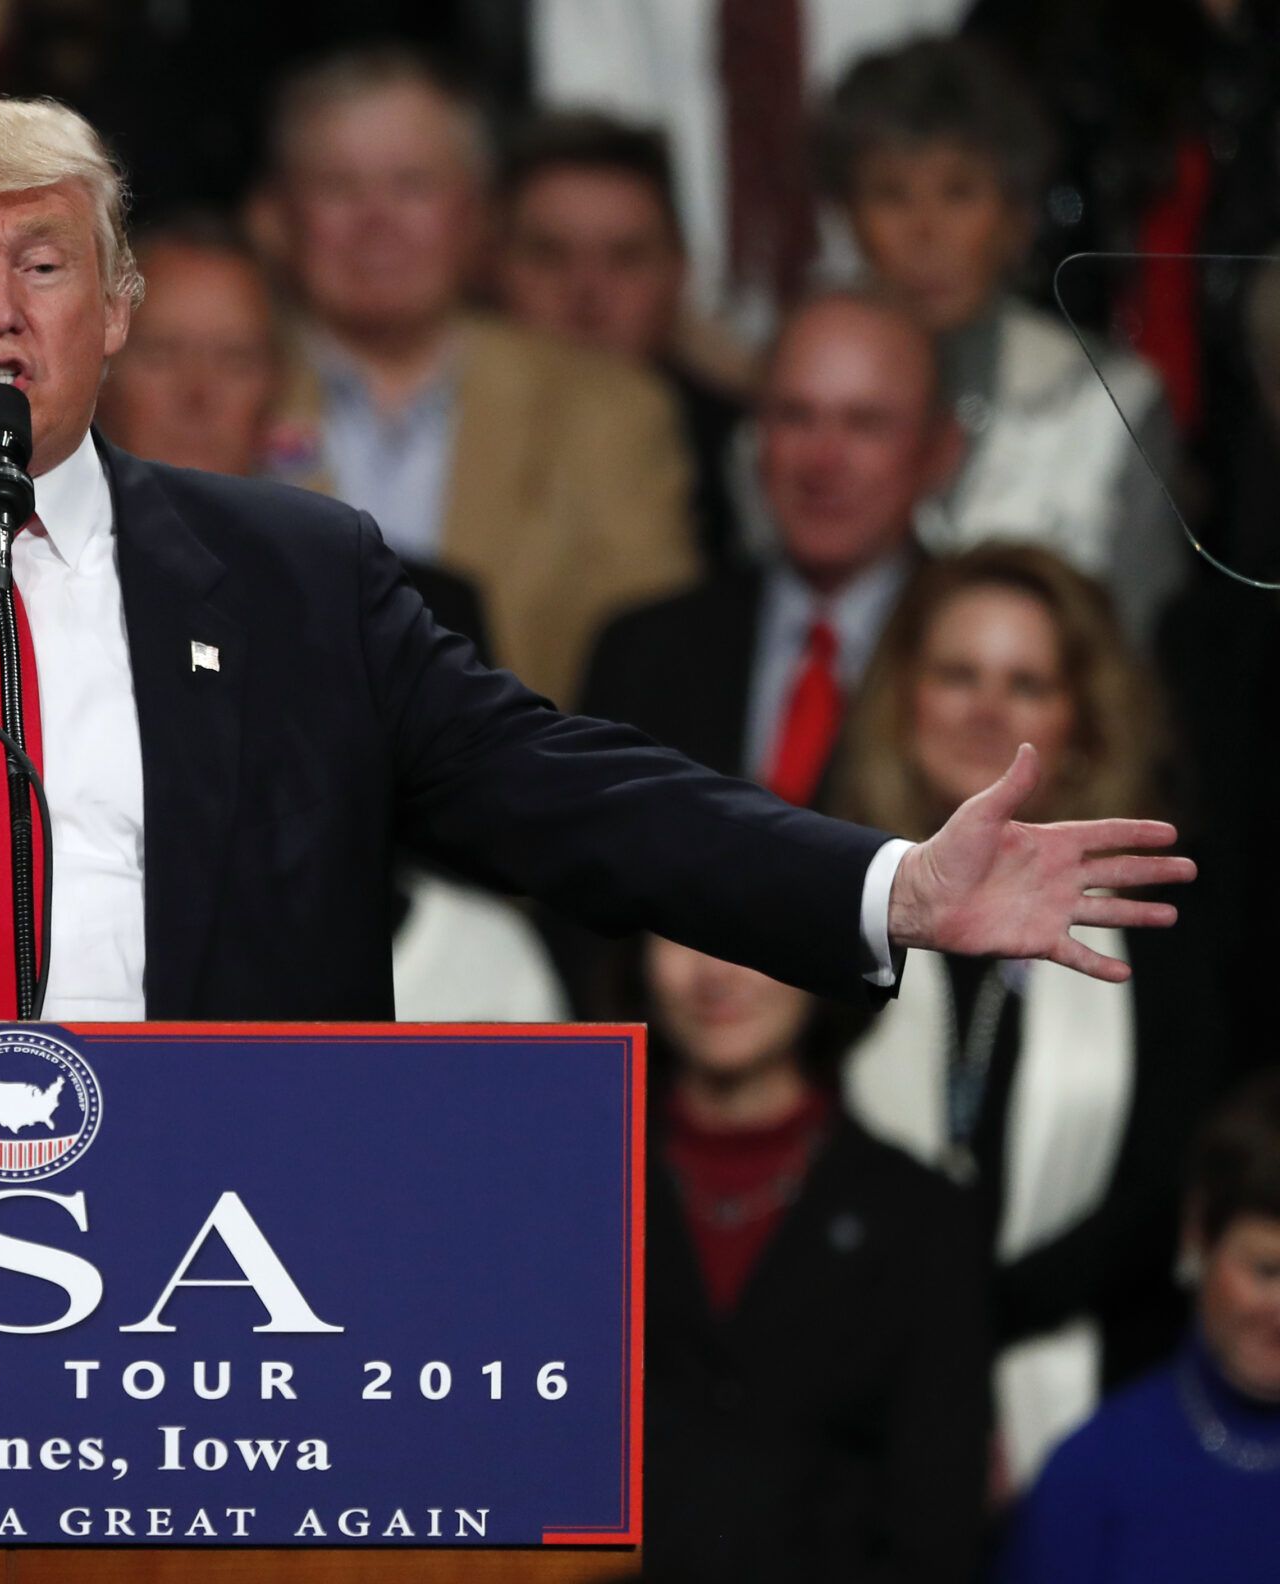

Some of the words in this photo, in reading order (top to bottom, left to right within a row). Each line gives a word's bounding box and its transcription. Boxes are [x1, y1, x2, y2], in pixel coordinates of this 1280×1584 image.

[13, 1046, 59, 1065] DONALD
[67, 1071, 86, 1112] TRUMP
[65, 1360, 299, 1400] TOUR
[361, 1360, 569, 1401] 2016
[157, 1426, 332, 1472] Iowa
[59, 1507, 256, 1537] GREAT
[293, 1508, 490, 1538] AGAIN
